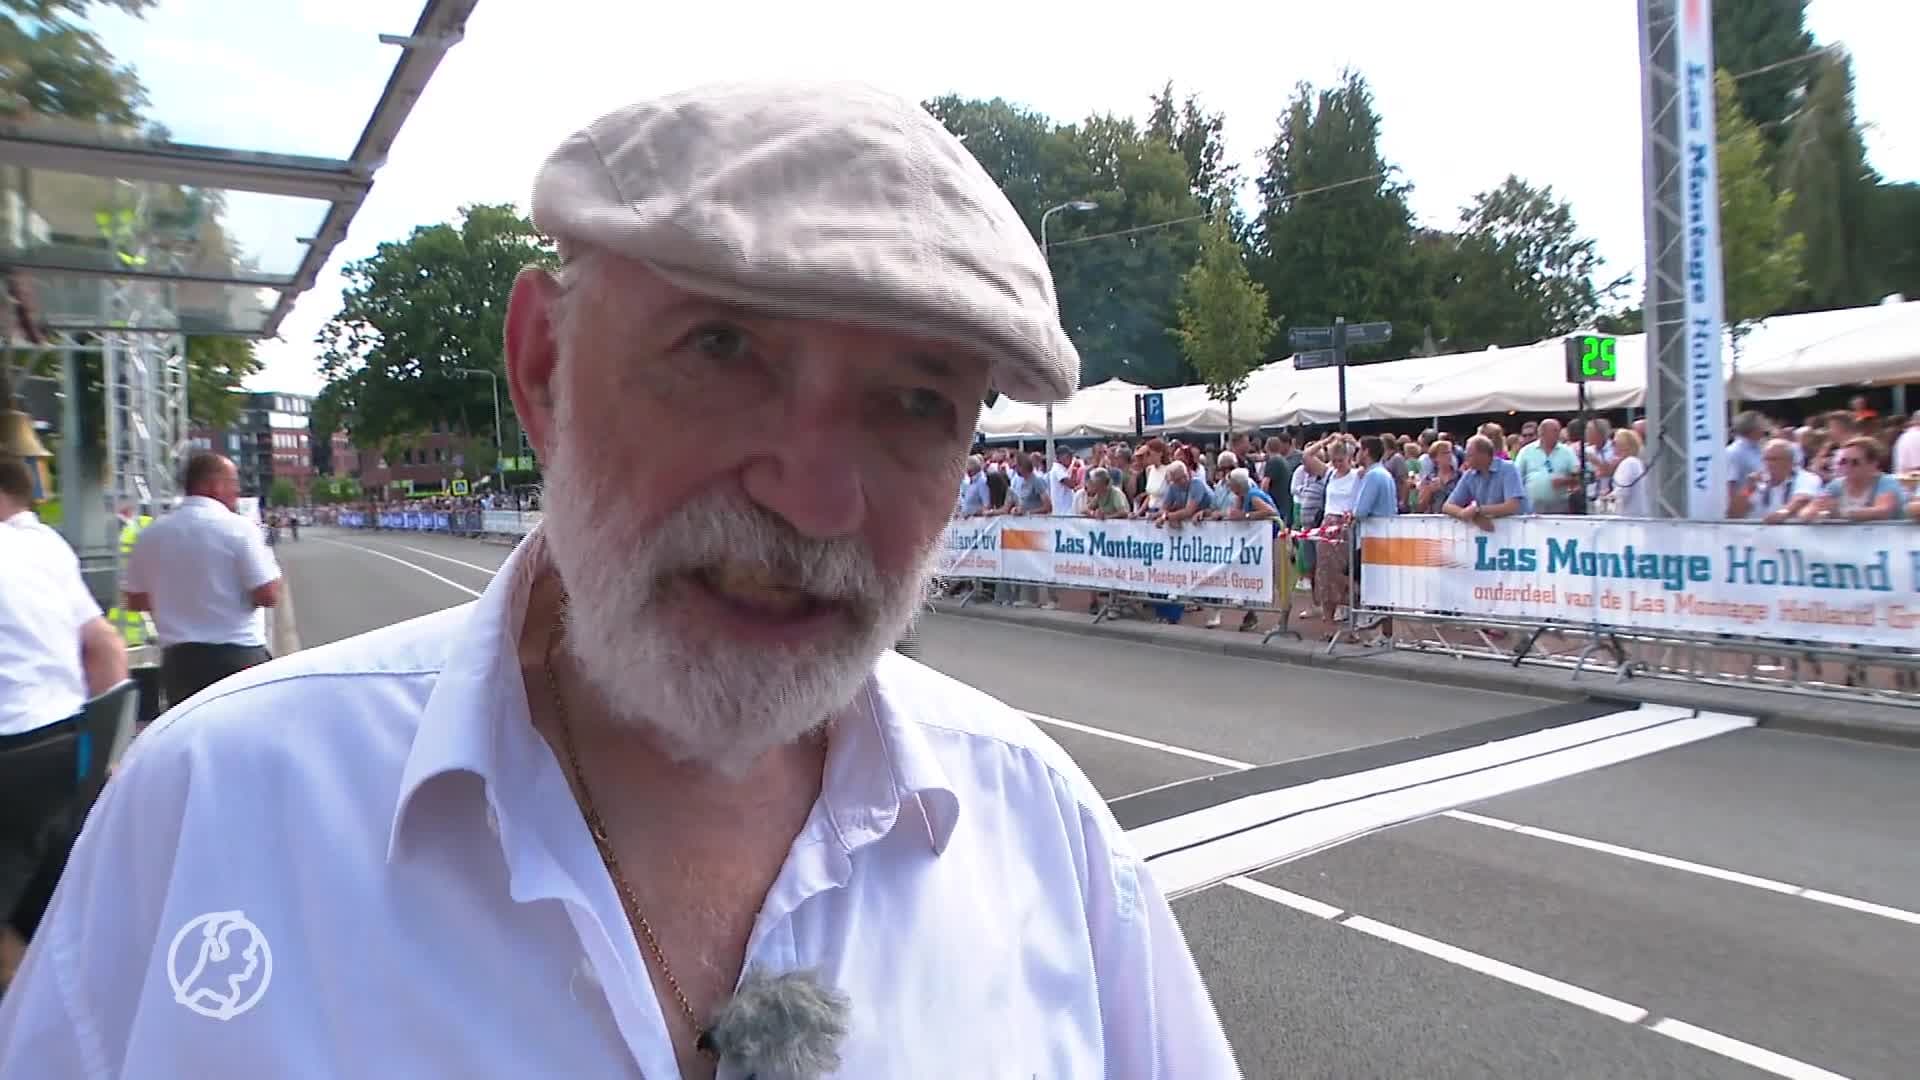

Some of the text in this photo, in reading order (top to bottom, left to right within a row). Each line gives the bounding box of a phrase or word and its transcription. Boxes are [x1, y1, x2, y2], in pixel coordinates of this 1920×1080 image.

[1583, 337, 1616, 376] 25
[1693, 317, 1712, 442] Holland
[1150, 397, 1160, 415] P
[1695, 455, 1712, 490] bv
[1055, 529, 1263, 566] Las Montage Holland bv
[1475, 536, 1536, 572] Las
[1546, 538, 1710, 591] Montage
[1725, 545, 1893, 592] Holland
[1474, 582, 1556, 604] onderdeel
[1564, 592, 1595, 608] van
[1601, 588, 1621, 610] de
[1630, 590, 1665, 613] Las
